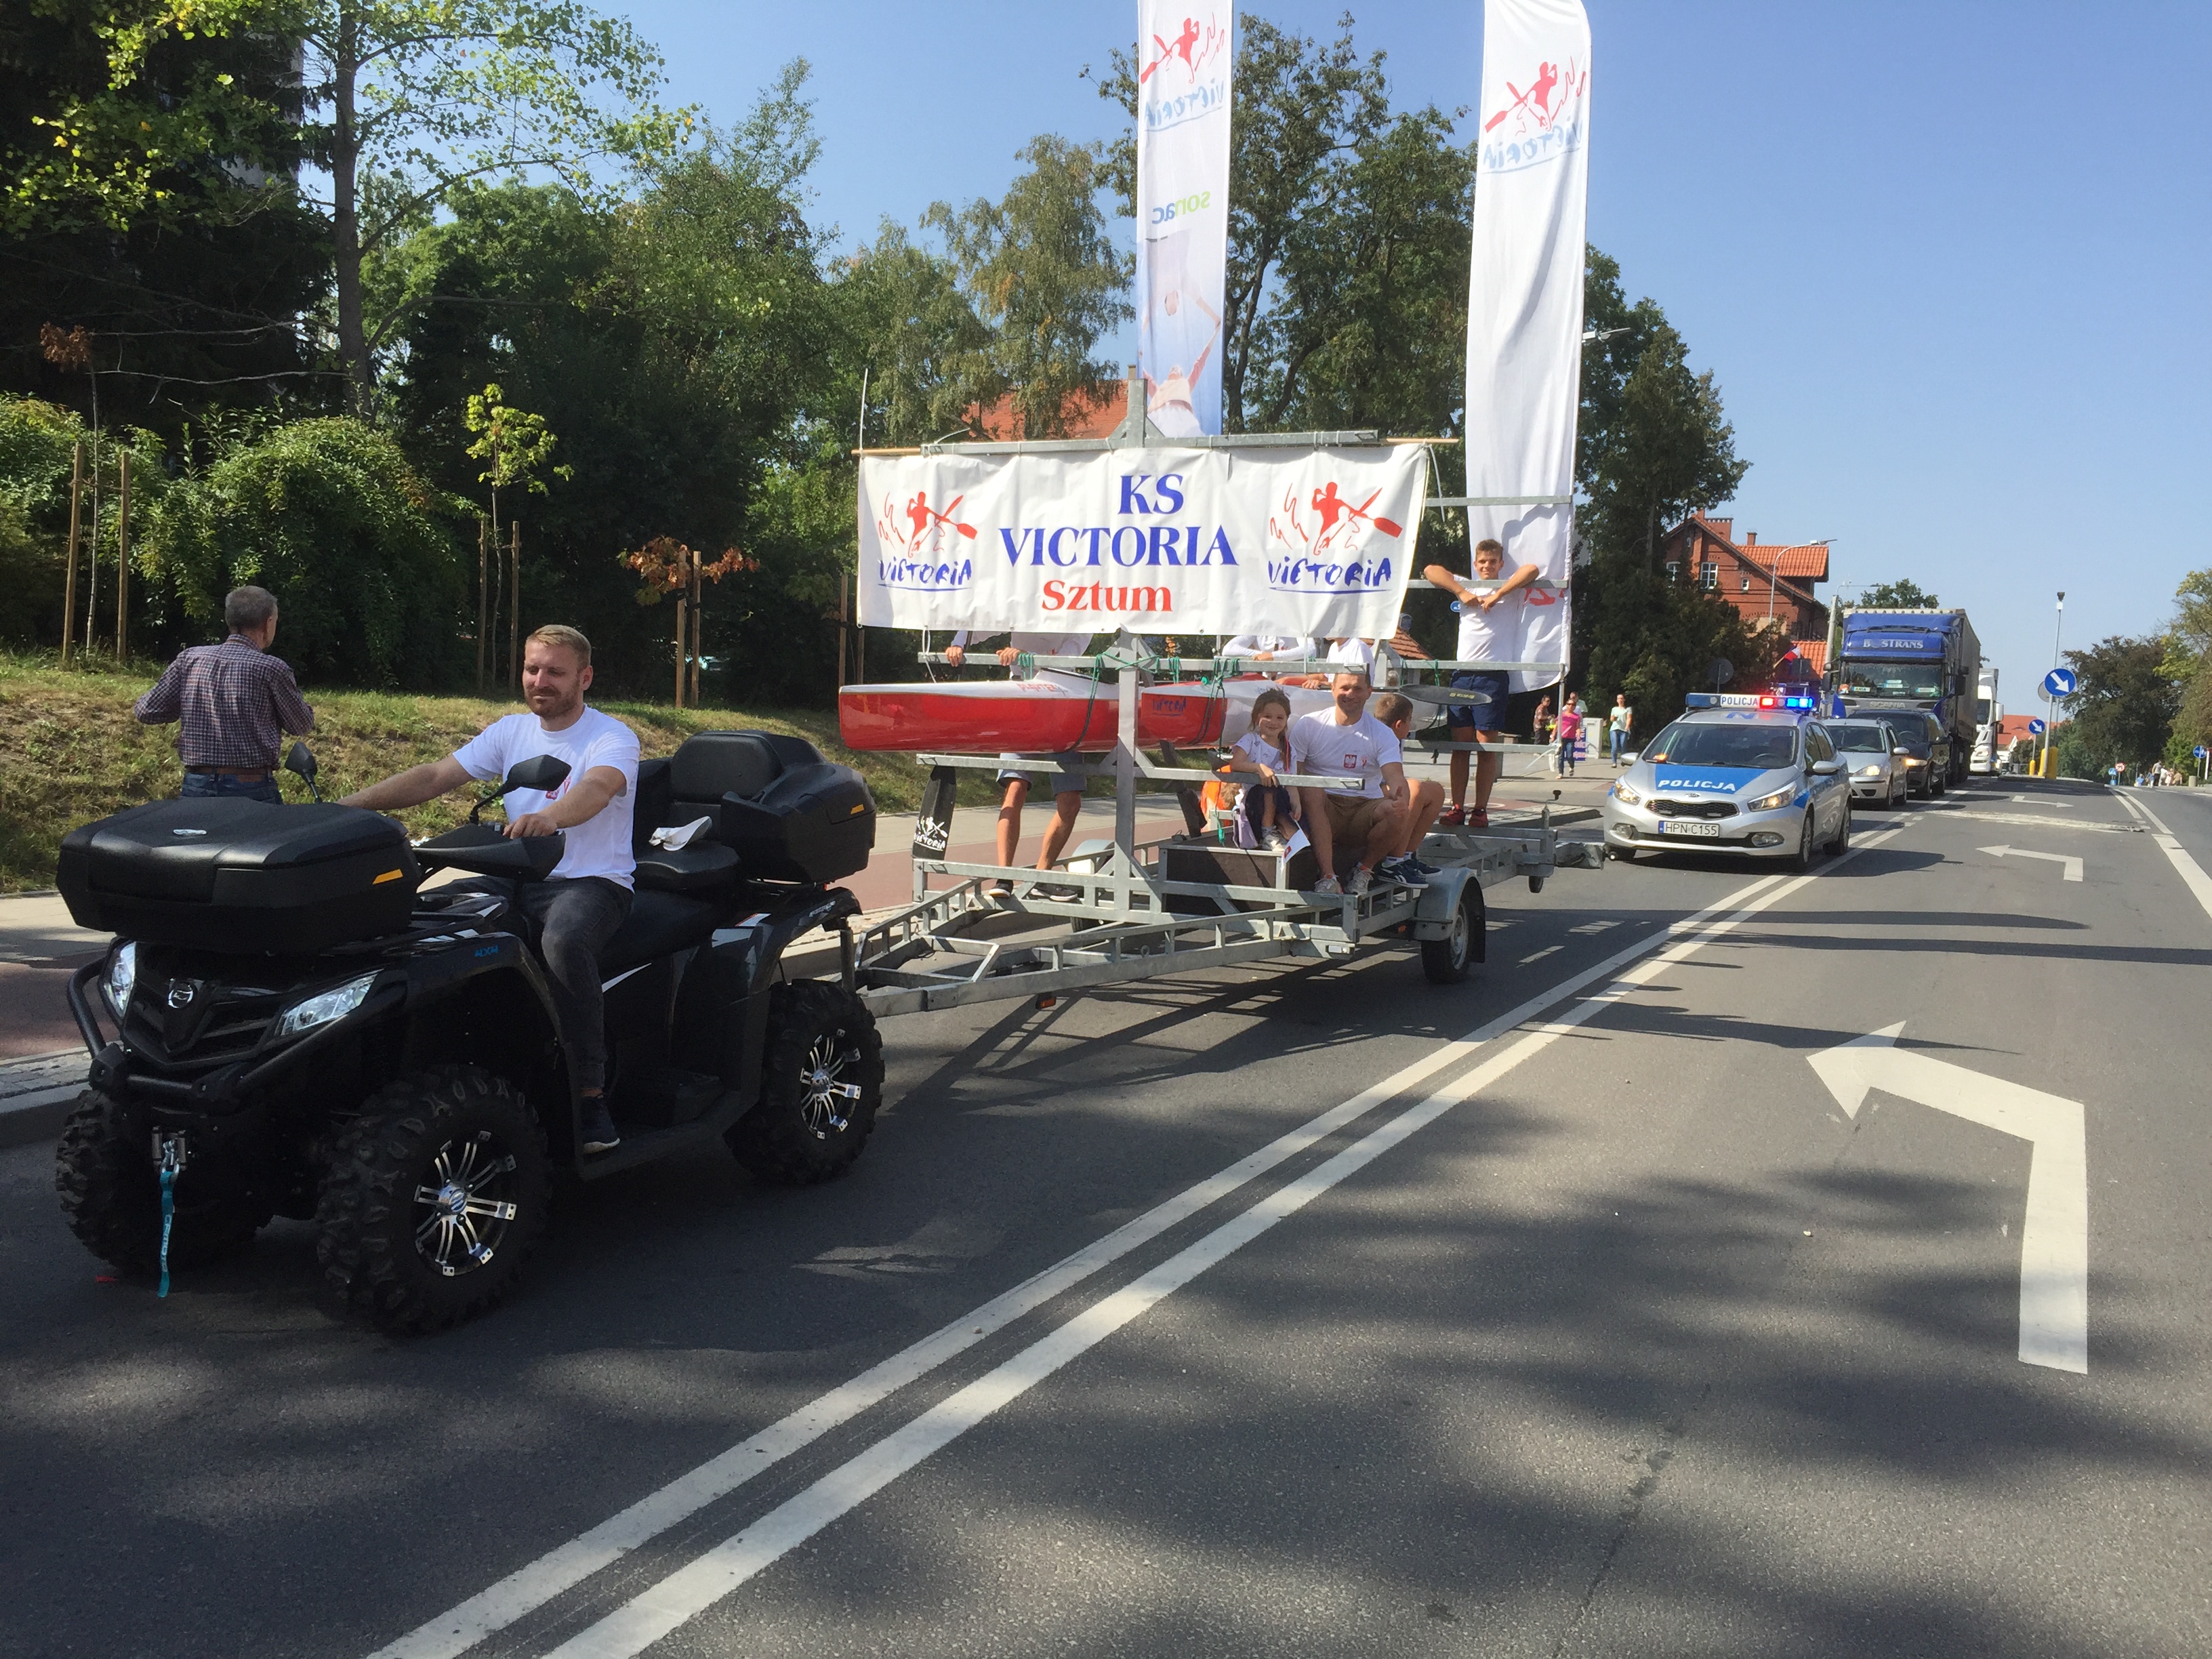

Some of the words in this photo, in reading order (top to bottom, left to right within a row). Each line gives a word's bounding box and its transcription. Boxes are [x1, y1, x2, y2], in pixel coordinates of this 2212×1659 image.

[1117, 474, 1185, 515] KS
[998, 525, 1240, 568] VICTORIA
[1041, 579, 1173, 612] Sztum
[1862, 638, 1924, 649] BSTRANS
[1721, 696, 1759, 705] POLICJA
[1869, 701, 1906, 709] SCANIA
[1658, 779, 1736, 792] POLICJA
[1665, 823, 1688, 834] HPN
[1691, 824, 1717, 835] C155
